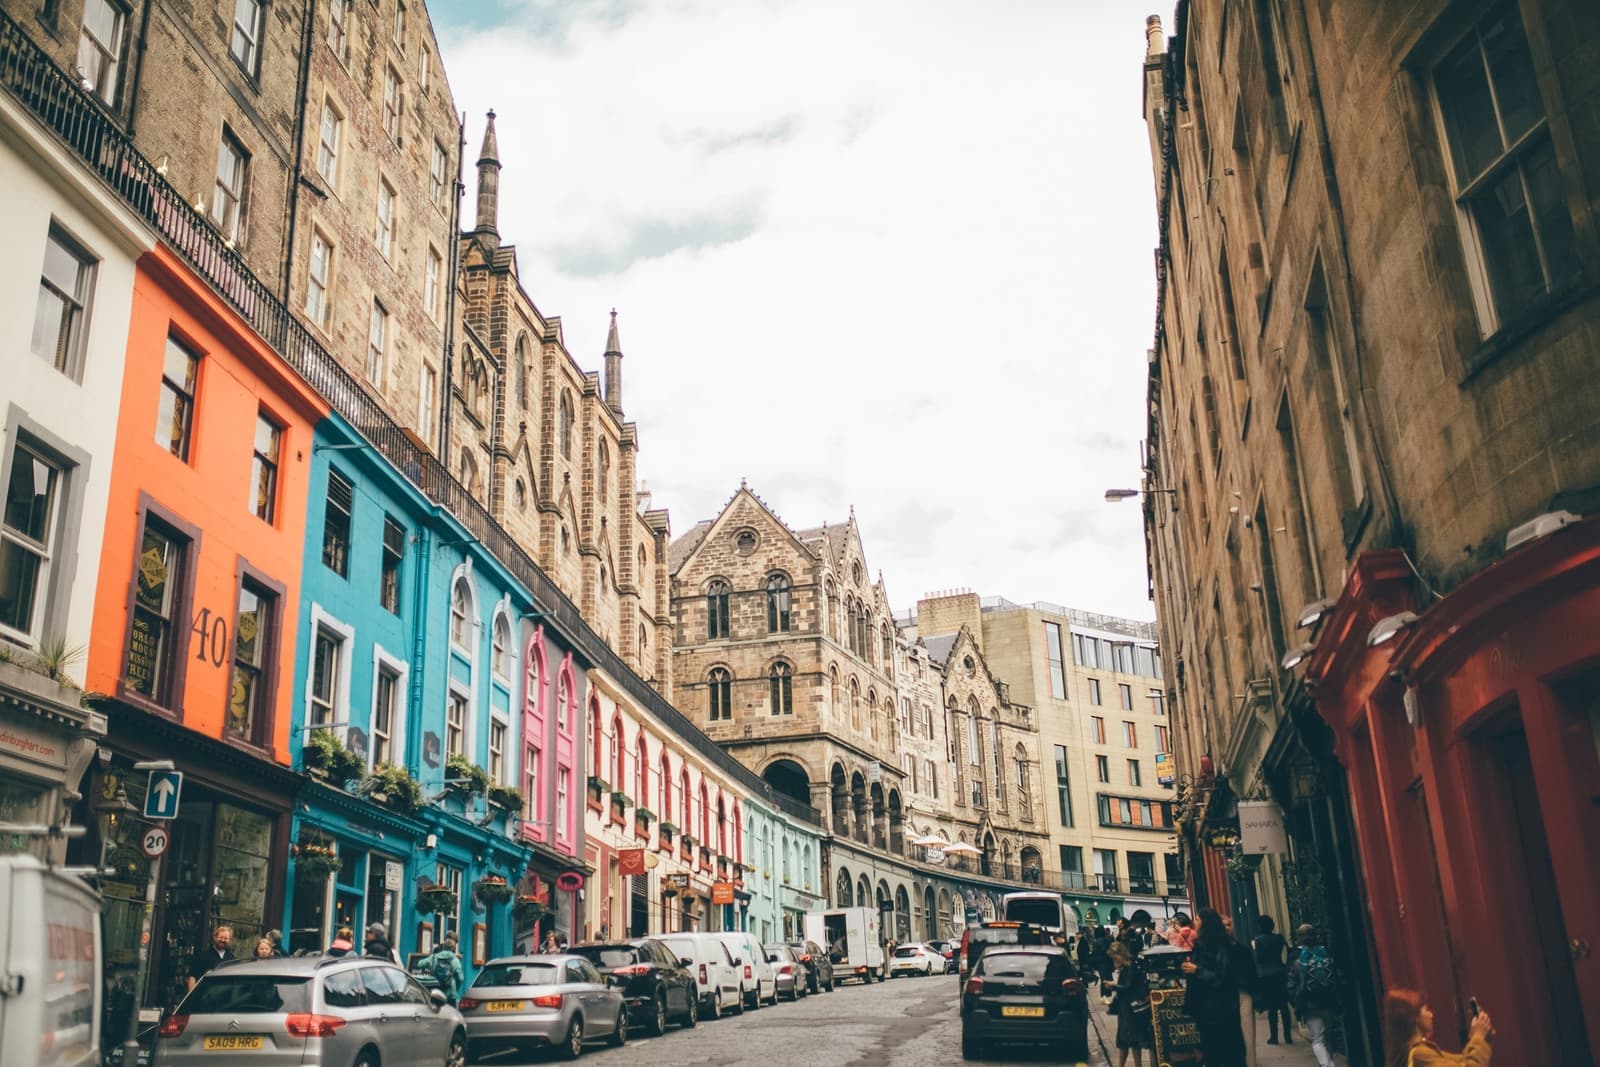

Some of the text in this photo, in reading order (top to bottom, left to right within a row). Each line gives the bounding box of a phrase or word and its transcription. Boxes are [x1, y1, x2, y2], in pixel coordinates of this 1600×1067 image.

[192, 607, 227, 668] 40
[0, 731, 55, 757] dinburghart.com
[146, 835, 166, 850] 20
[208, 1037, 259, 1048] SA09 HRG
